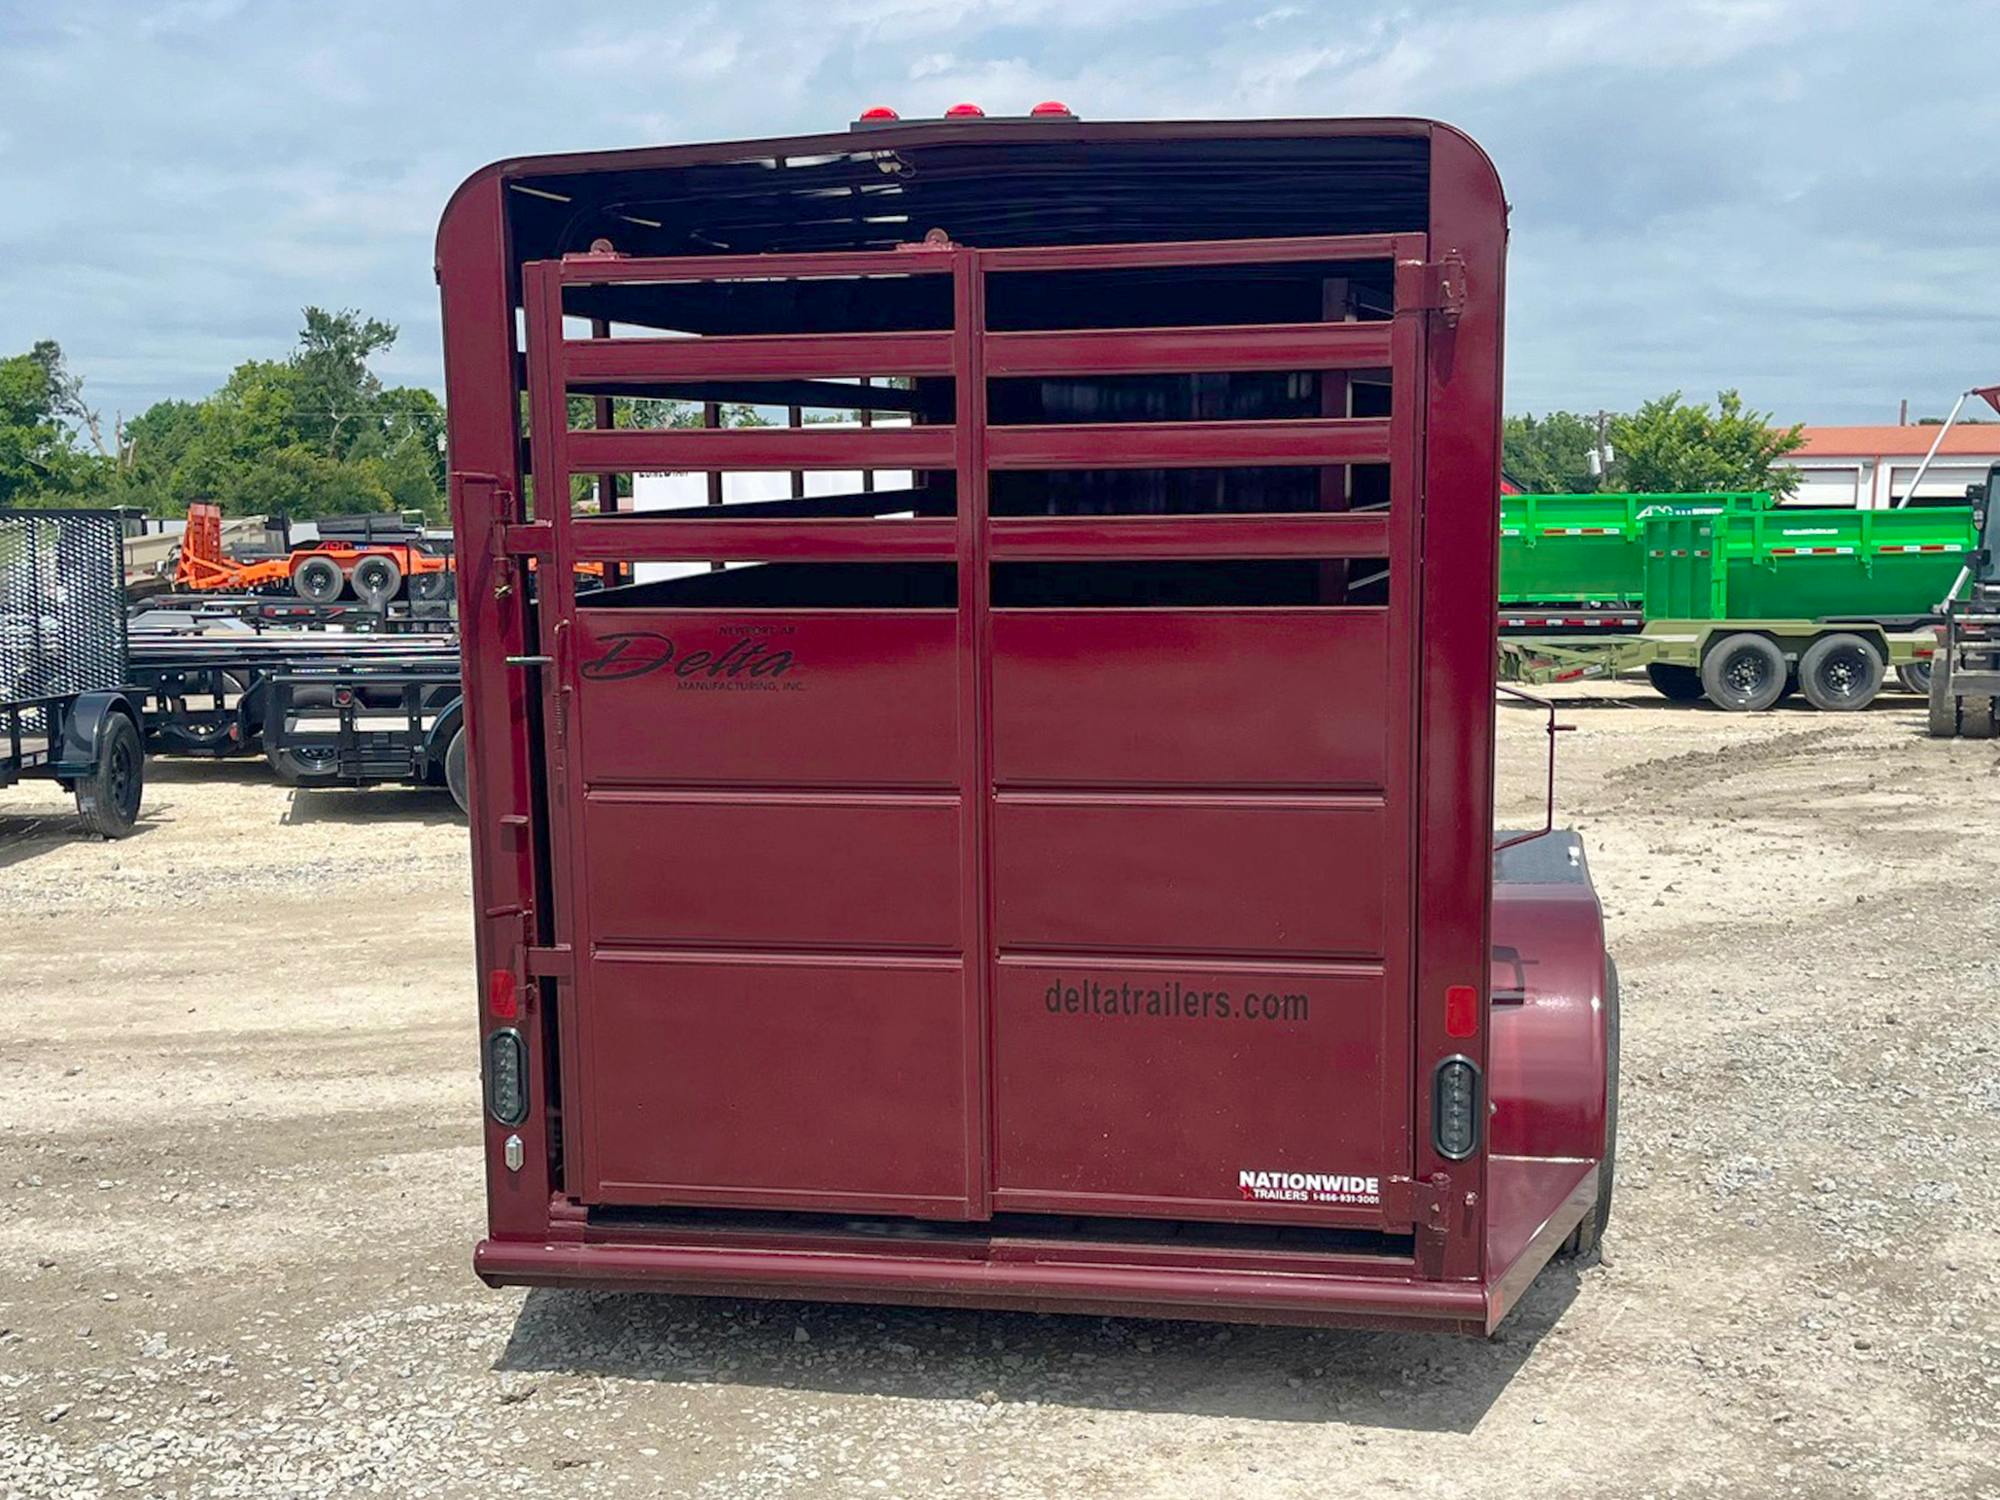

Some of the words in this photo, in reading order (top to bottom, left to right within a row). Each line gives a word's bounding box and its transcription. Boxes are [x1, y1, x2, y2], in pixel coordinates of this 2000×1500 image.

[580, 632, 796, 681] Delta
[1046, 978, 1309, 1021] deltatrailers.com
[1239, 1170, 1379, 1194] NATIONWIDE
[1253, 1188, 1308, 1201] TRAILERS
